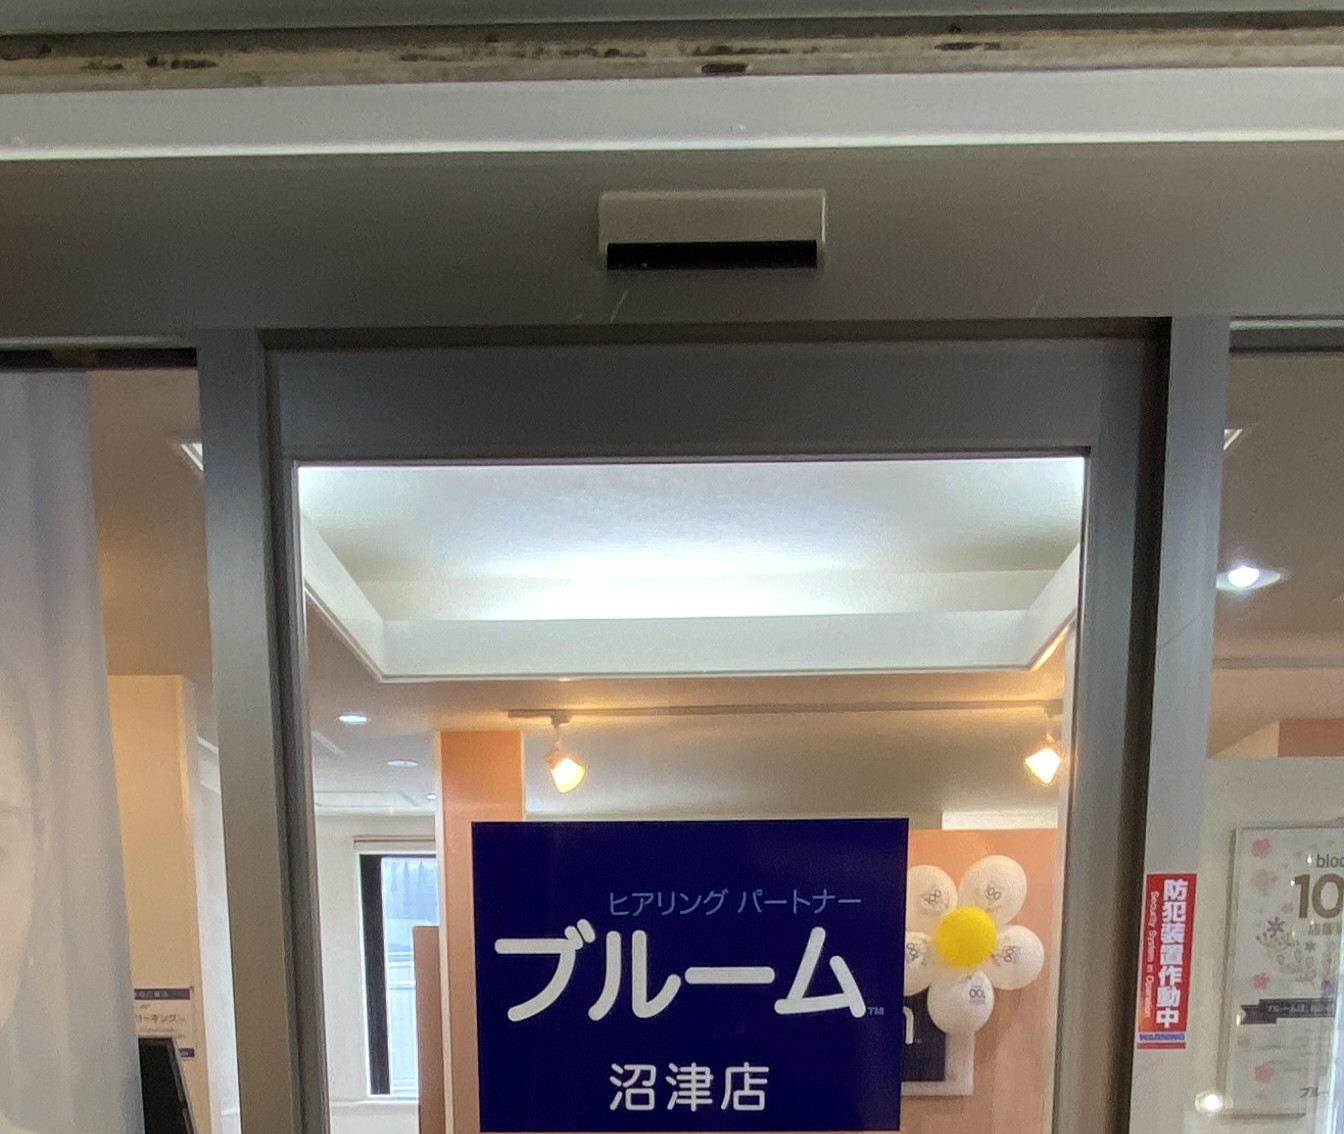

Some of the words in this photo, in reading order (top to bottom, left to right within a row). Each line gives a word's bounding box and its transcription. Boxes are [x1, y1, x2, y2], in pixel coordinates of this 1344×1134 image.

[609, 889, 729, 917] ヒアリング
[737, 888, 863, 915] パートナー
[1148, 890, 1159, 928] Security
[494, 918, 866, 1022] ブルーム
[1156, 879, 1188, 1029] 防犯装置作動中
[609, 1062, 769, 1112] 沼津店
